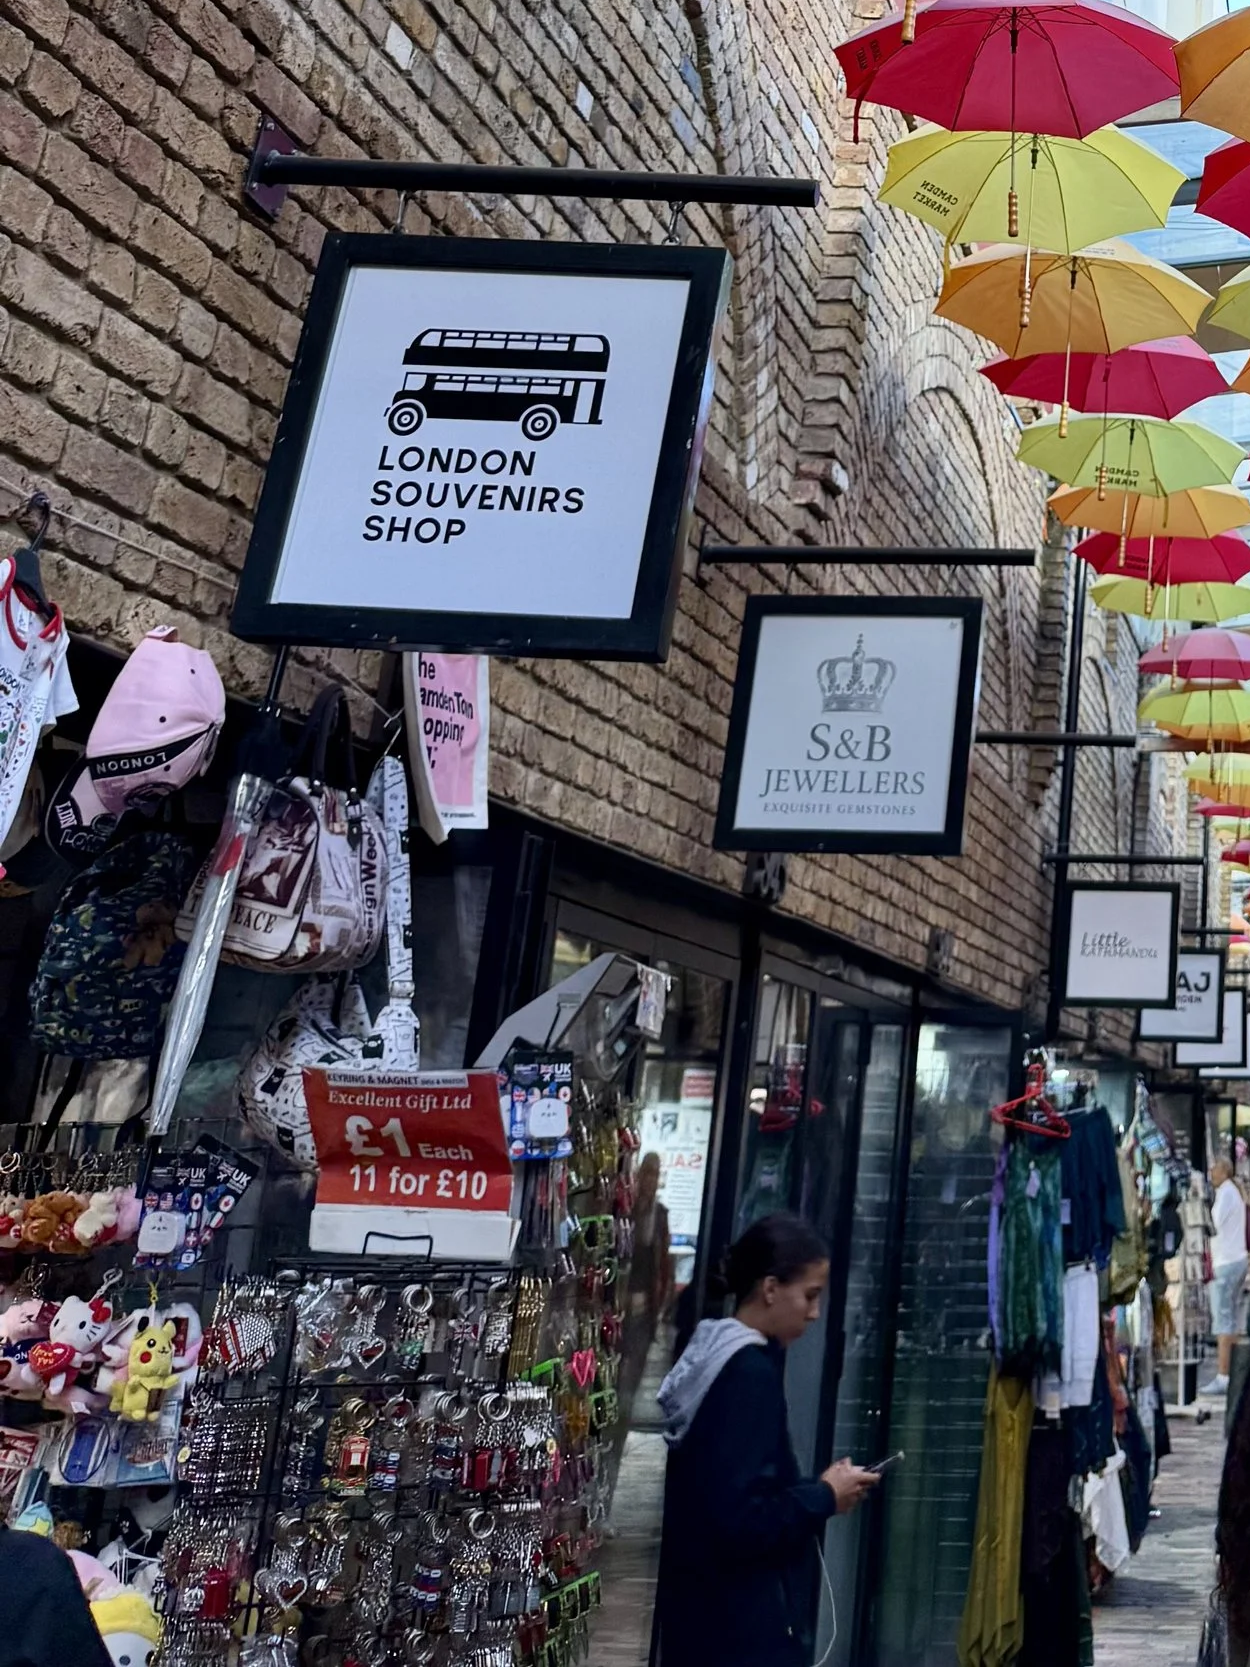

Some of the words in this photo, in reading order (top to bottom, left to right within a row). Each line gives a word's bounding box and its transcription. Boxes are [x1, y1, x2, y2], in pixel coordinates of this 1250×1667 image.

[378, 445, 536, 476] LONDON
[369, 479, 586, 514] SOUVENIRS
[362, 514, 467, 544] SHOP
[418, 652, 436, 680] he
[419, 686, 455, 715] amden
[423, 716, 465, 746] opping
[806, 723, 892, 762] S&B
[96, 751, 167, 775] LONDON
[759, 768, 926, 798] JEWELLERS
[55, 800, 78, 829] LDN
[763, 802, 832, 815] EXQUISITE
[836, 803, 917, 816] GEMSTONES
[232, 906, 278, 935] EACE
[1081, 931, 1132, 947] Little
[1176, 971, 1211, 993] AJ
[377, 1075, 418, 1085] MAGNET
[554, 1062, 572, 1074] UK
[328, 1090, 402, 1108] Excellent
[405, 1094, 439, 1113] Gift
[442, 1094, 472, 1110] Ltd
[344, 1115, 412, 1158] £1
[418, 1143, 474, 1161] Each
[191, 1168, 207, 1179] UK
[231, 1169, 252, 1187] UK
[350, 1164, 376, 1192] 11
[388, 1166, 430, 1196] for
[436, 1169, 488, 1200] £10
